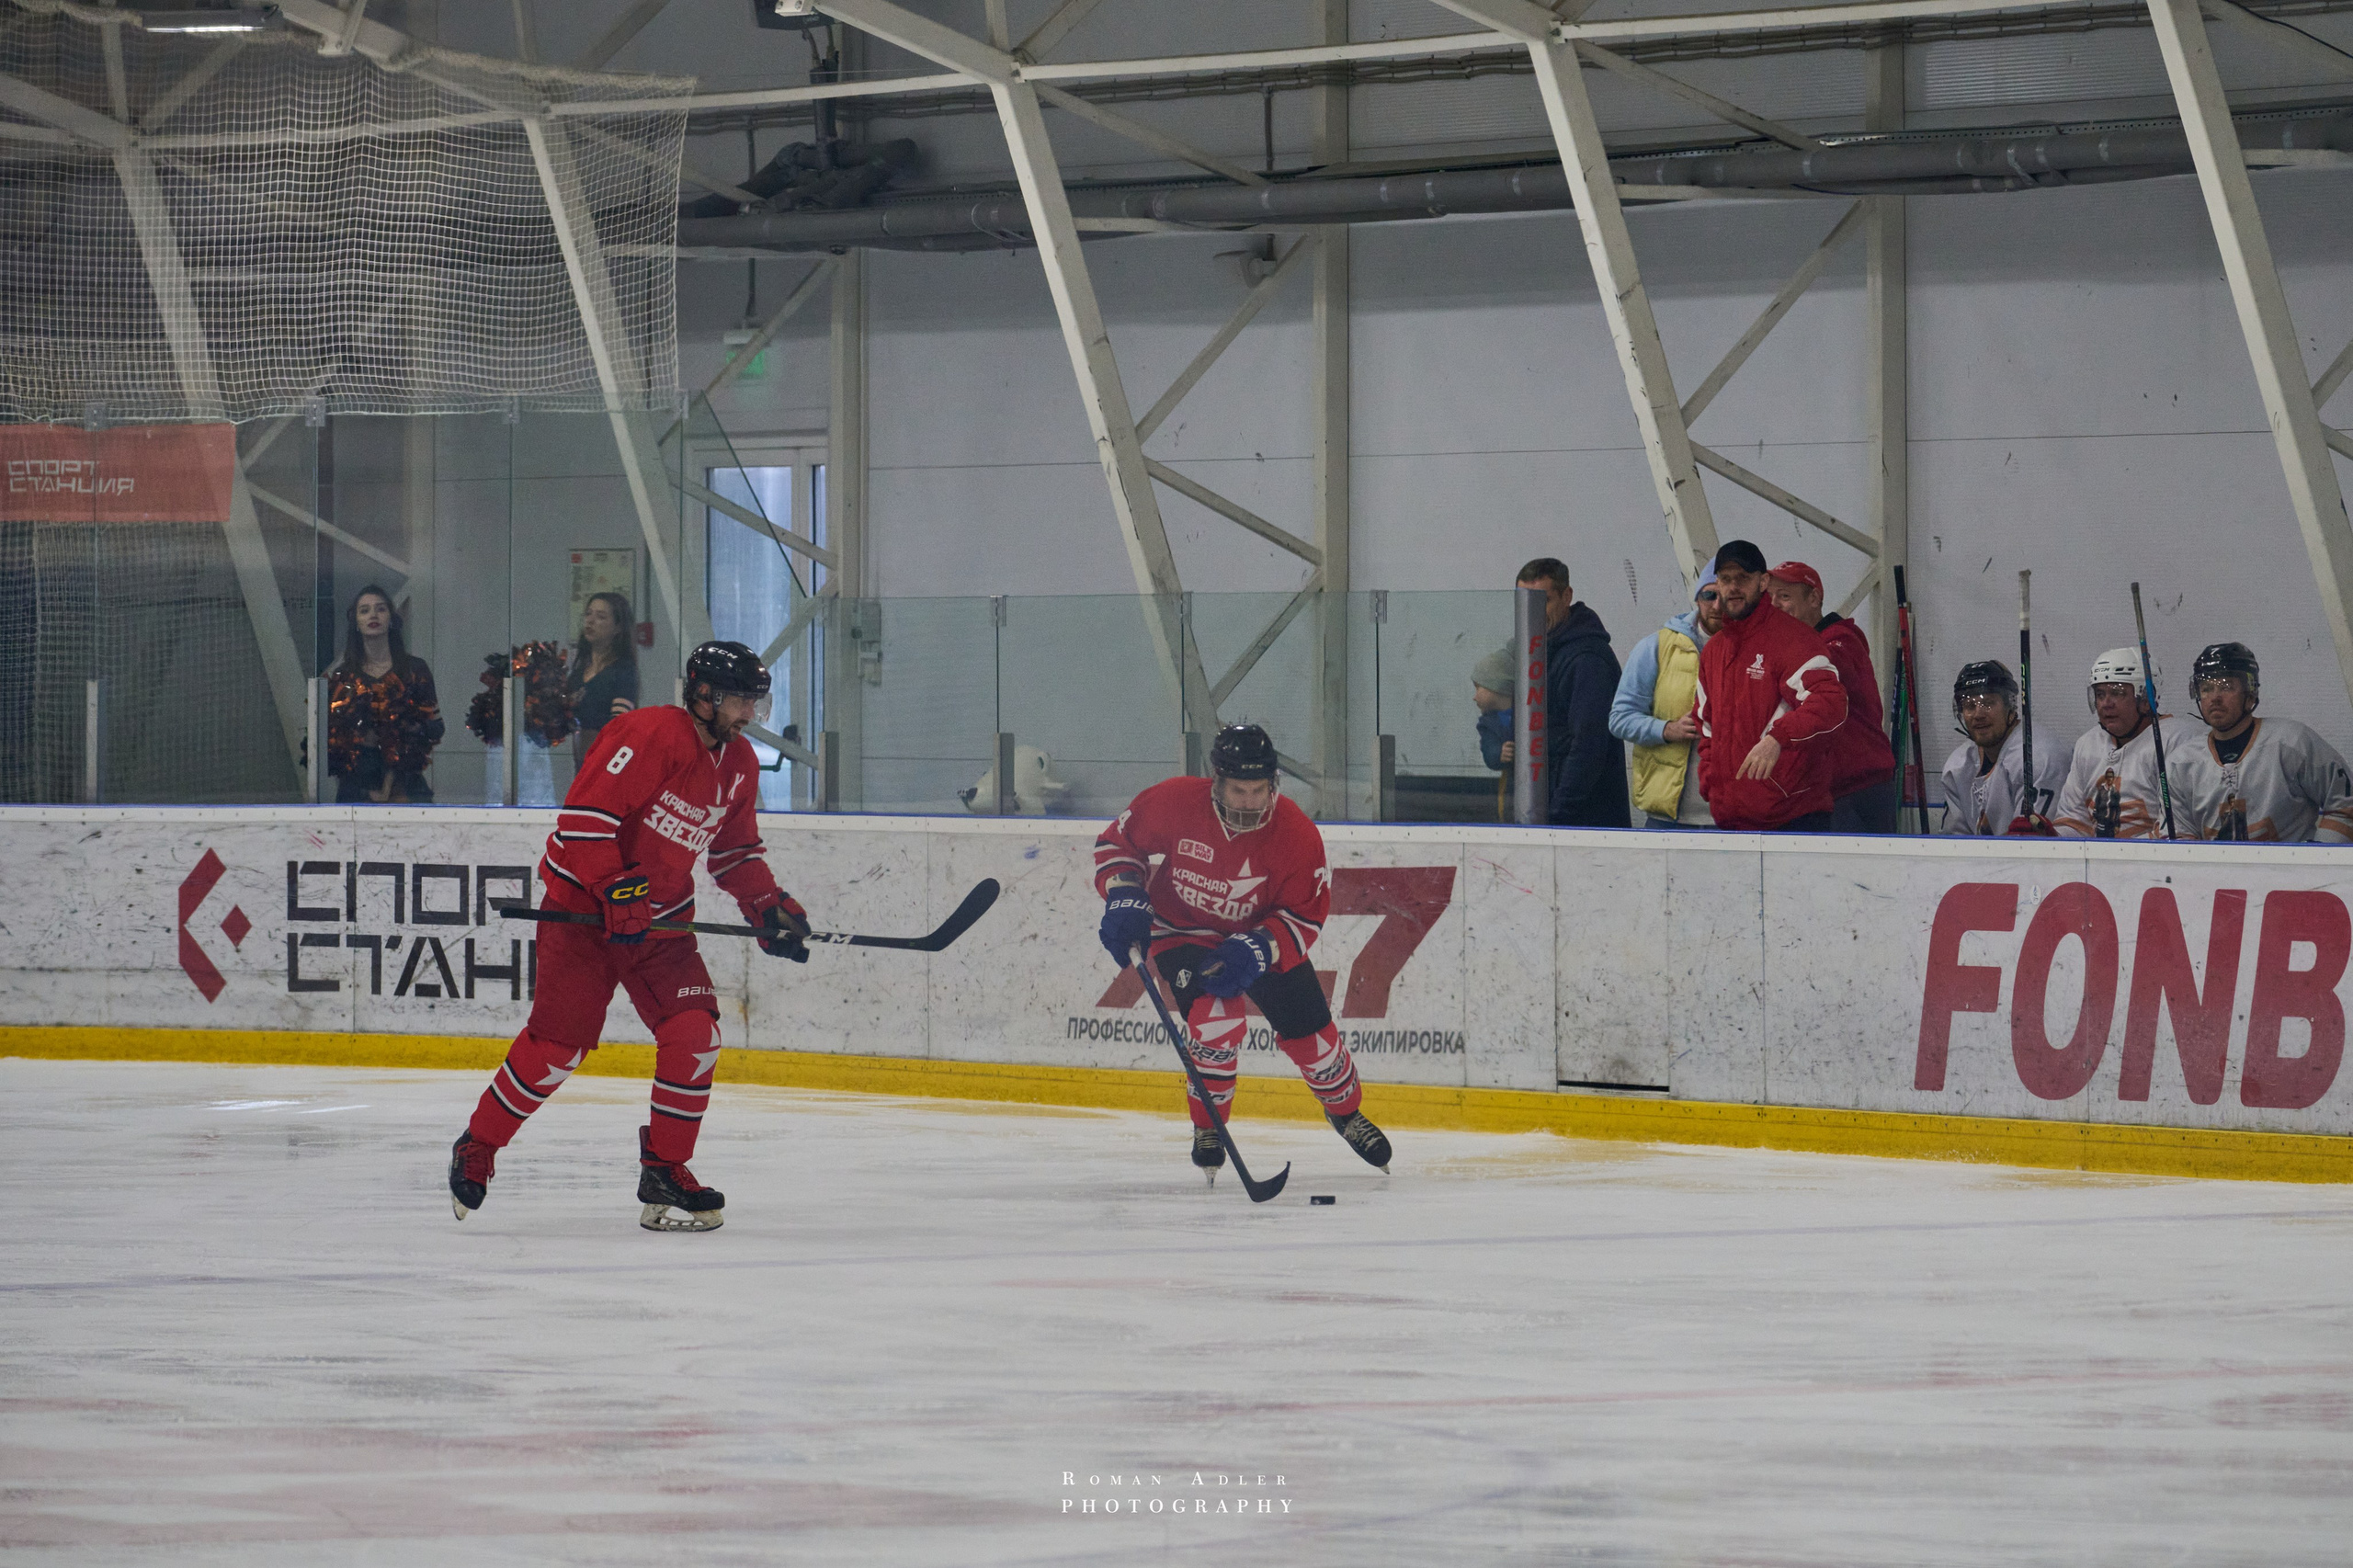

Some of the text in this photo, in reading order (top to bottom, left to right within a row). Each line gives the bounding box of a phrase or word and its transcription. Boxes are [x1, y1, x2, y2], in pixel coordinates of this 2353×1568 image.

[7, 460, 99, 475] СПОРТ
[9, 476, 134, 495] СТАНЦИЯ
[1965, 677, 1986, 686] CCM
[1527, 635, 1543, 781] FONBET
[606, 745, 634, 775] 8
[659, 790, 707, 824] КРАСНАЯ
[287, 860, 542, 926] СПОР
[611, 882, 650, 900] CC
[1173, 867, 1229, 895] КРАСНАЯ
[1108, 897, 1155, 915] BAUE
[287, 932, 538, 1001] СТАН
[677, 986, 715, 998] BAU
[1914, 881, 2351, 1110] FONB
[1350, 1029, 1466, 1054] ЭКИПИРОВКА
